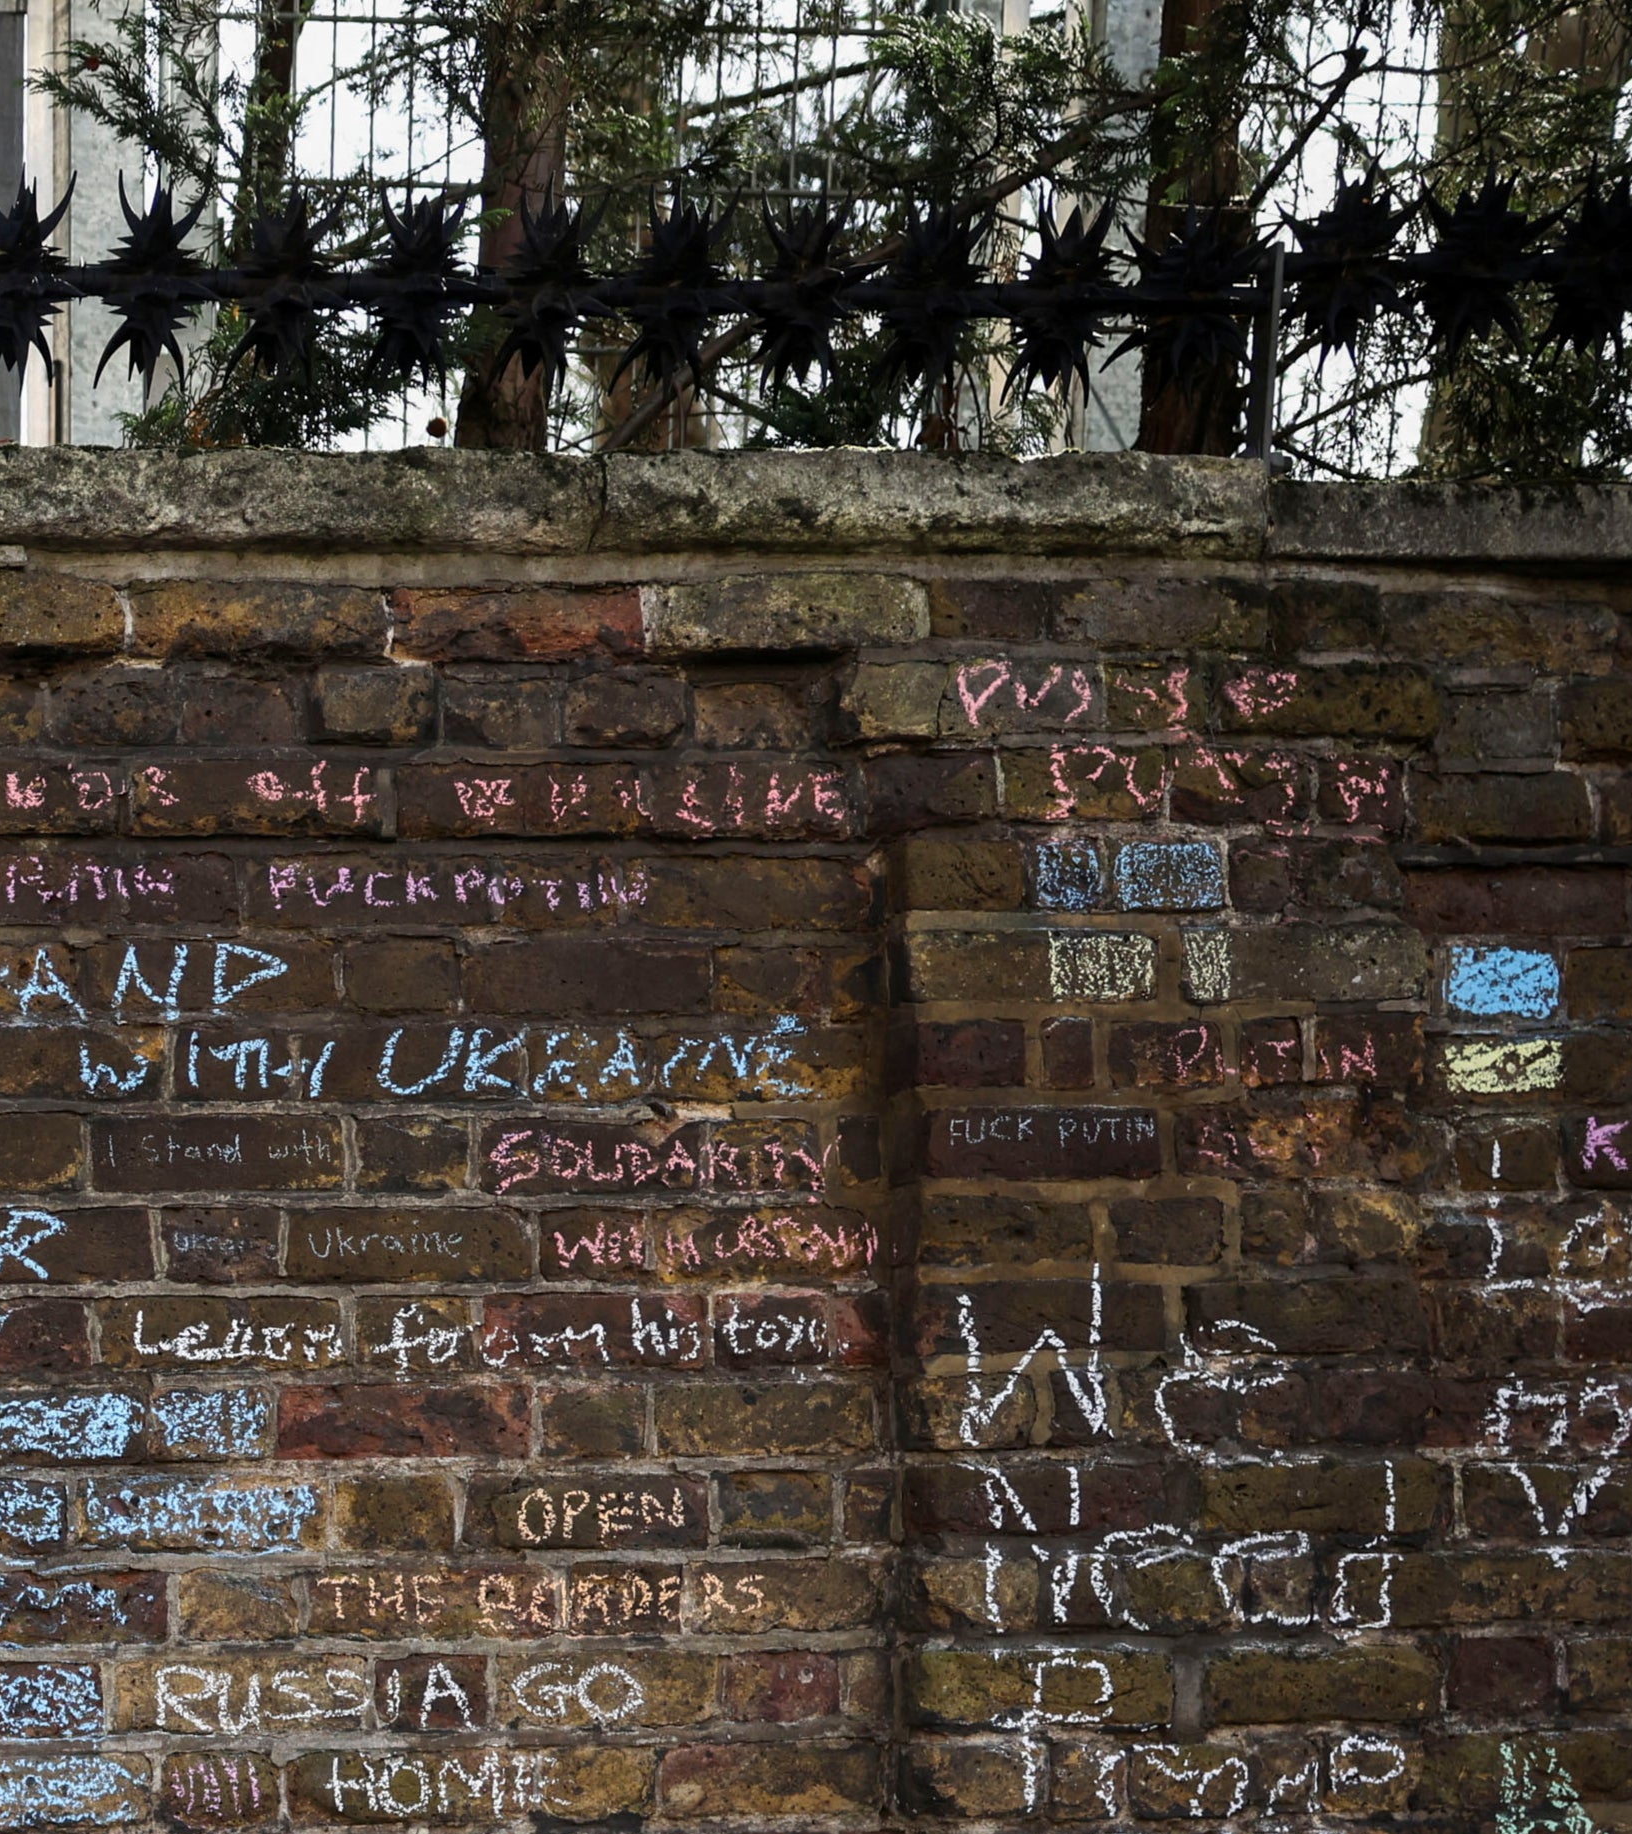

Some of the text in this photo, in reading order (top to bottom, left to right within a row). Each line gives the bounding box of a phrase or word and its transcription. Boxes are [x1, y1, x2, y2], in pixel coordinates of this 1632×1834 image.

[948, 1115, 1035, 1145] FUCK
[1057, 1115, 1157, 1149] PUTIN
[515, 1484, 685, 1547] OPEN
[315, 1572, 444, 1626] THE
[154, 1661, 646, 1736] RUSSIA GO
[325, 1752, 573, 1822] HOME
